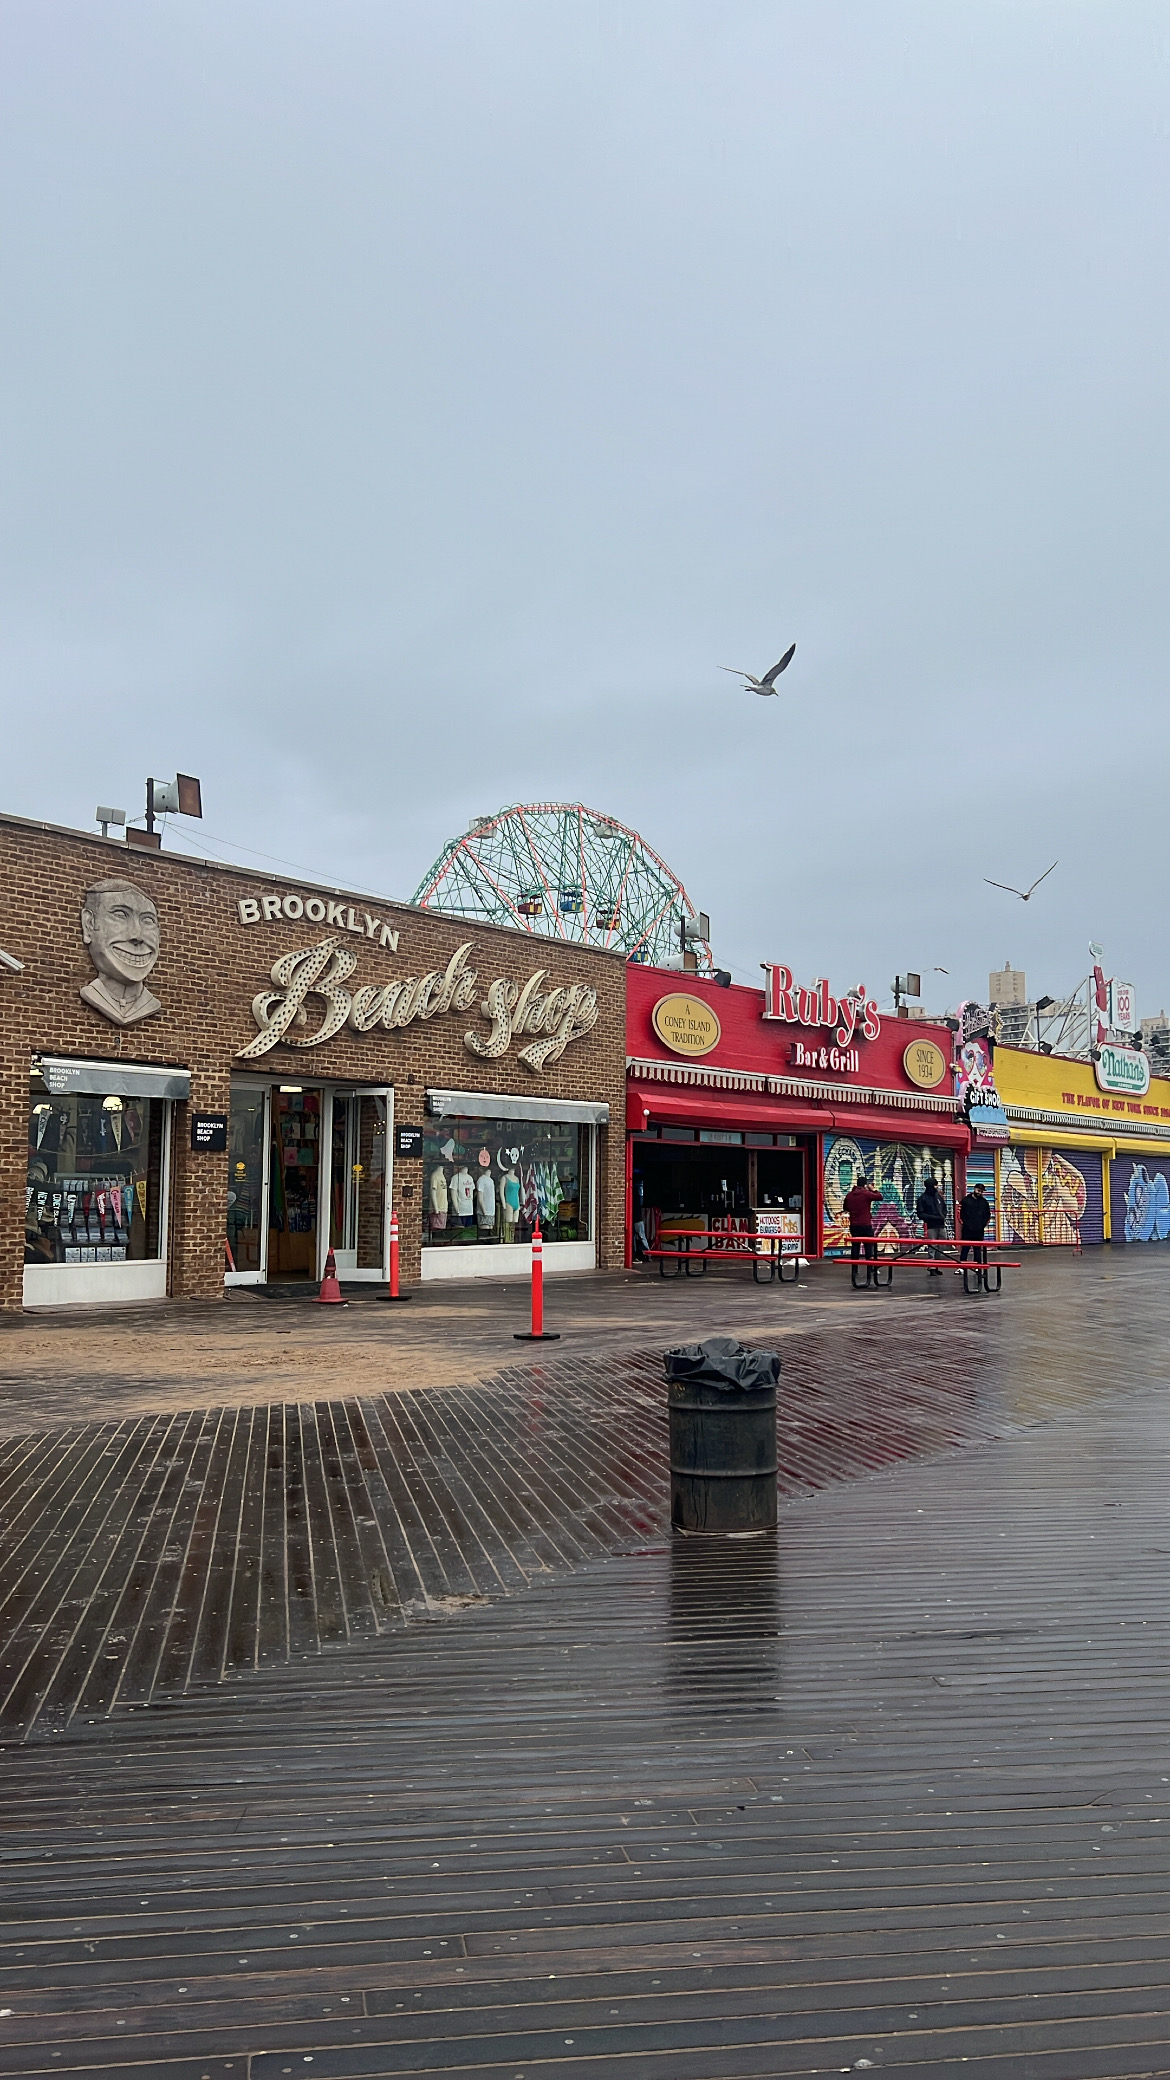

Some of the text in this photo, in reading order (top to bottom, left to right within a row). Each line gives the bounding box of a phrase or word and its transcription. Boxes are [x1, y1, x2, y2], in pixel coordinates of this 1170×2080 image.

[238, 895, 400, 953] BROOKLYN
[235, 936, 600, 1074] Beach Shop
[685, 1004, 691, 1015] A
[760, 961, 880, 1048] Ruby's
[1117, 996, 1130, 1012] 100
[1117, 1011, 1131, 1021] YEARS
[664, 1016, 711, 1032] CONEY ISLAND
[671, 1031, 705, 1046] TRADITION
[916, 1048, 934, 1064] SINCE
[49, 1067, 81, 1076] BROOKLYN
[918, 1064, 933, 1079] 1934
[1102, 1048, 1145, 1082] Nathan's
[49, 1074, 68, 1082] BEACH
[1062, 1092, 1075, 1104] THE
[1077, 1094, 1100, 1108] FLAVOR
[1102, 1098, 1110, 1109] OF
[1112, 1100, 1125, 1111] NEW
[197, 1121, 224, 1129] BROOKLYN
[712, 1218, 749, 1233] CLAM
[715, 1236, 747, 1249] BAR
